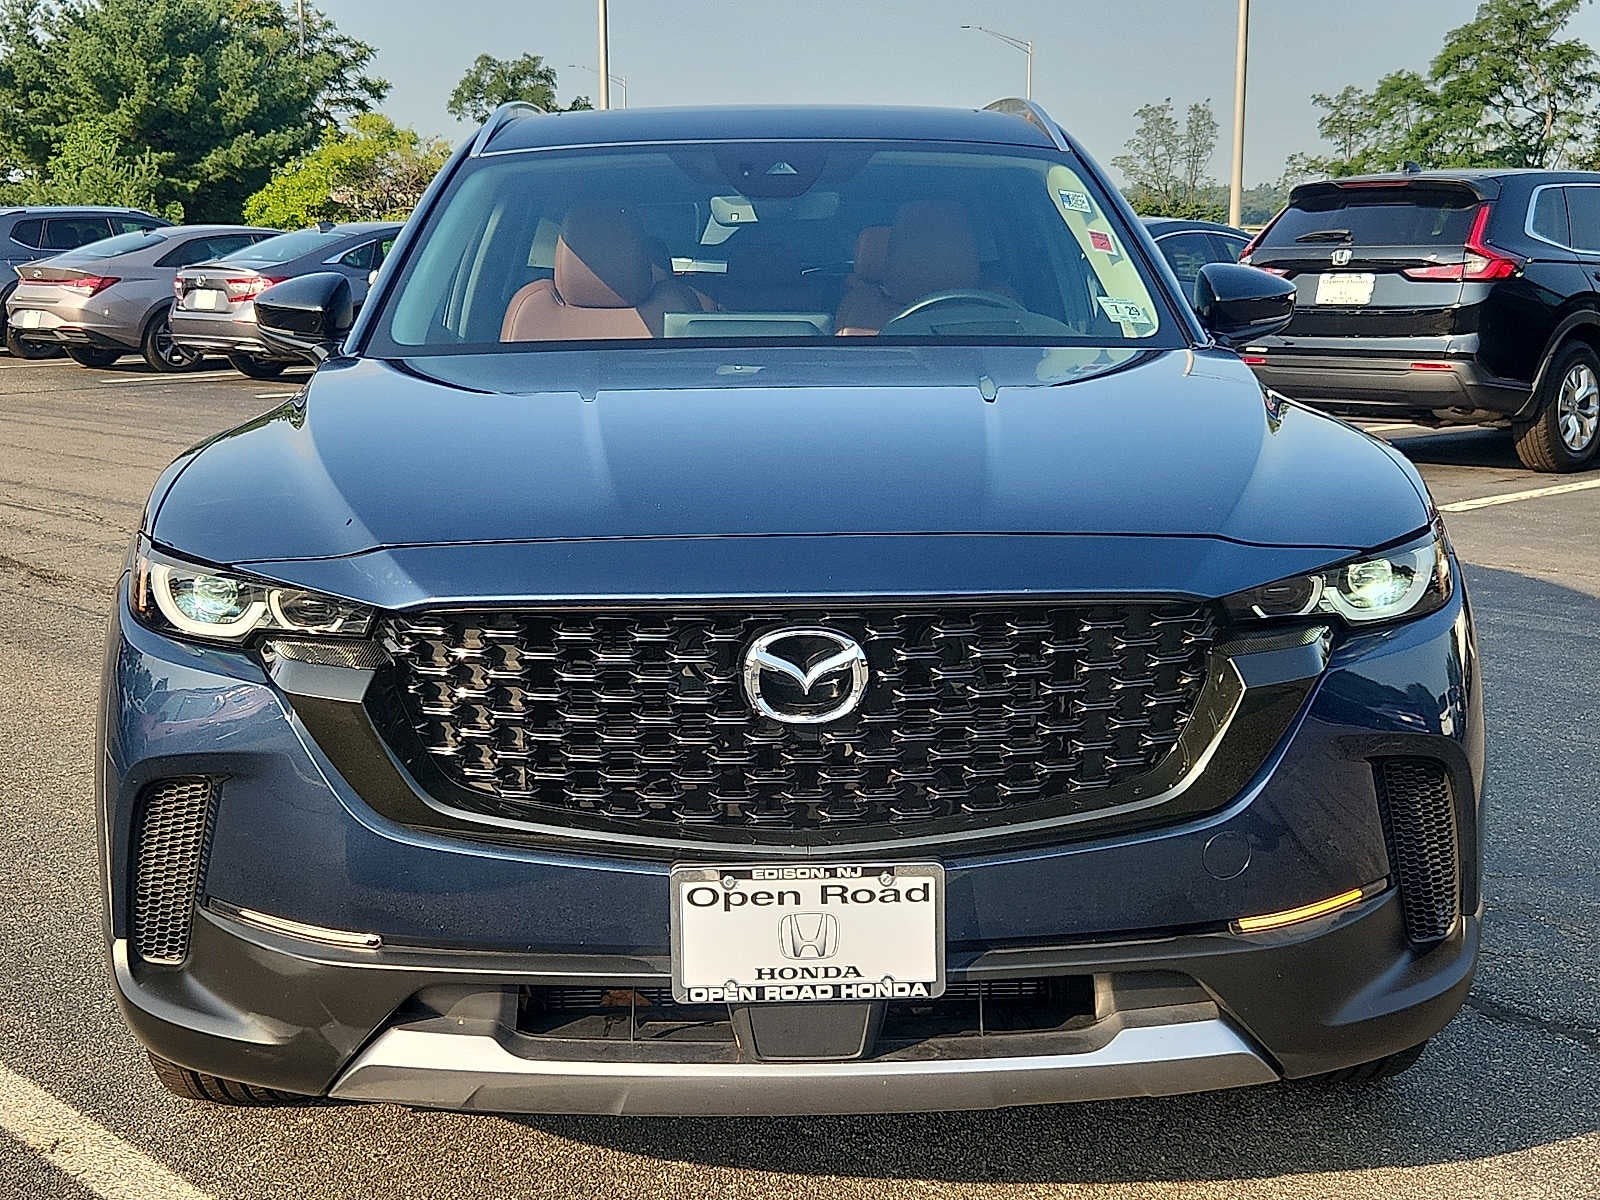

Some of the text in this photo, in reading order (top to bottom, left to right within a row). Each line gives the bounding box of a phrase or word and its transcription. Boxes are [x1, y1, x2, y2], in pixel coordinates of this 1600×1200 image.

[752, 866, 863, 880] EDISON, NJ
[686, 882, 930, 912] Open Road
[754, 965, 865, 981] HONDA
[689, 981, 929, 1002] OPEN ROAD HONDA
